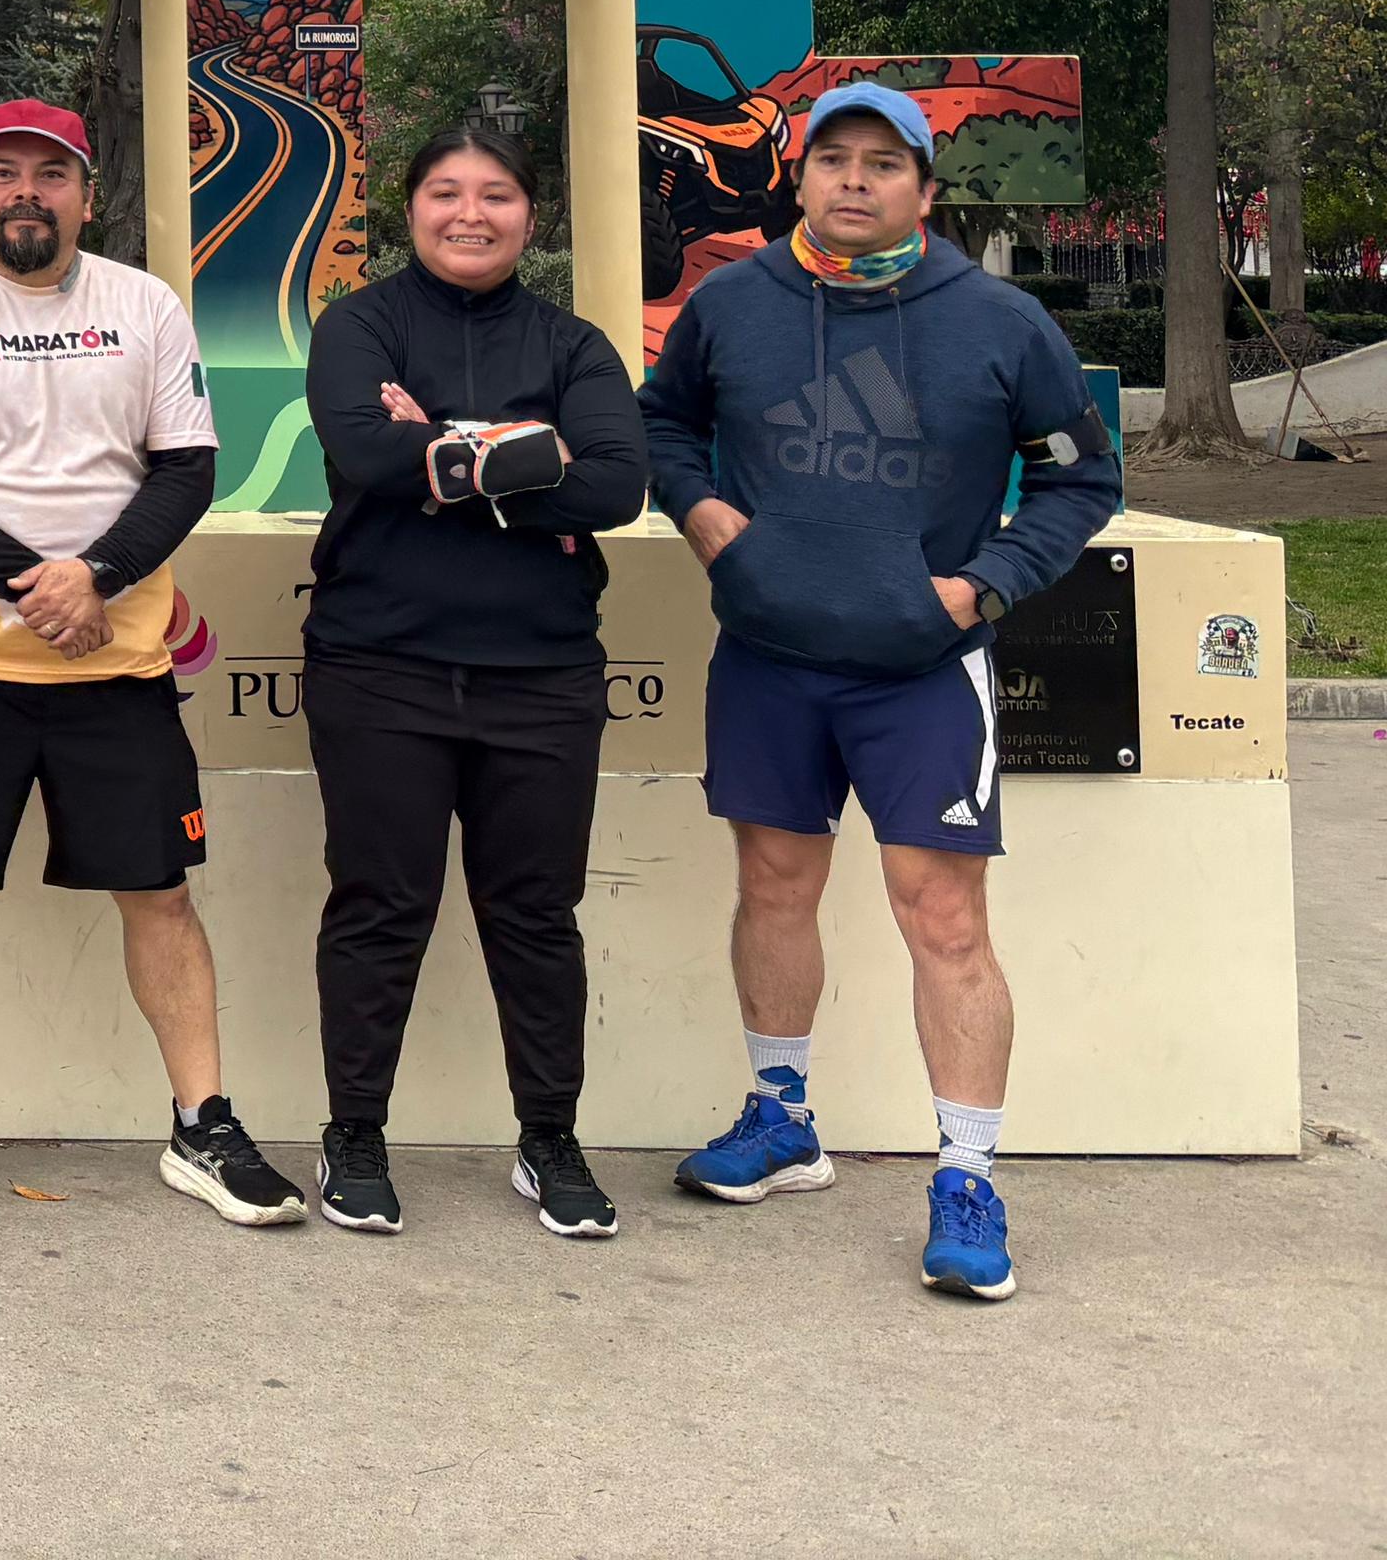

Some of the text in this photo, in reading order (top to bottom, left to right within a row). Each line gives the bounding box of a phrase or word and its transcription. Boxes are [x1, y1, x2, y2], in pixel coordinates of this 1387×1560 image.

[300, 32, 356, 44] LA RUMOROSA
[0, 325, 120, 352] MARATÓN
[1170, 713, 1245, 730] Tecate
[941, 814, 979, 827] adidas
